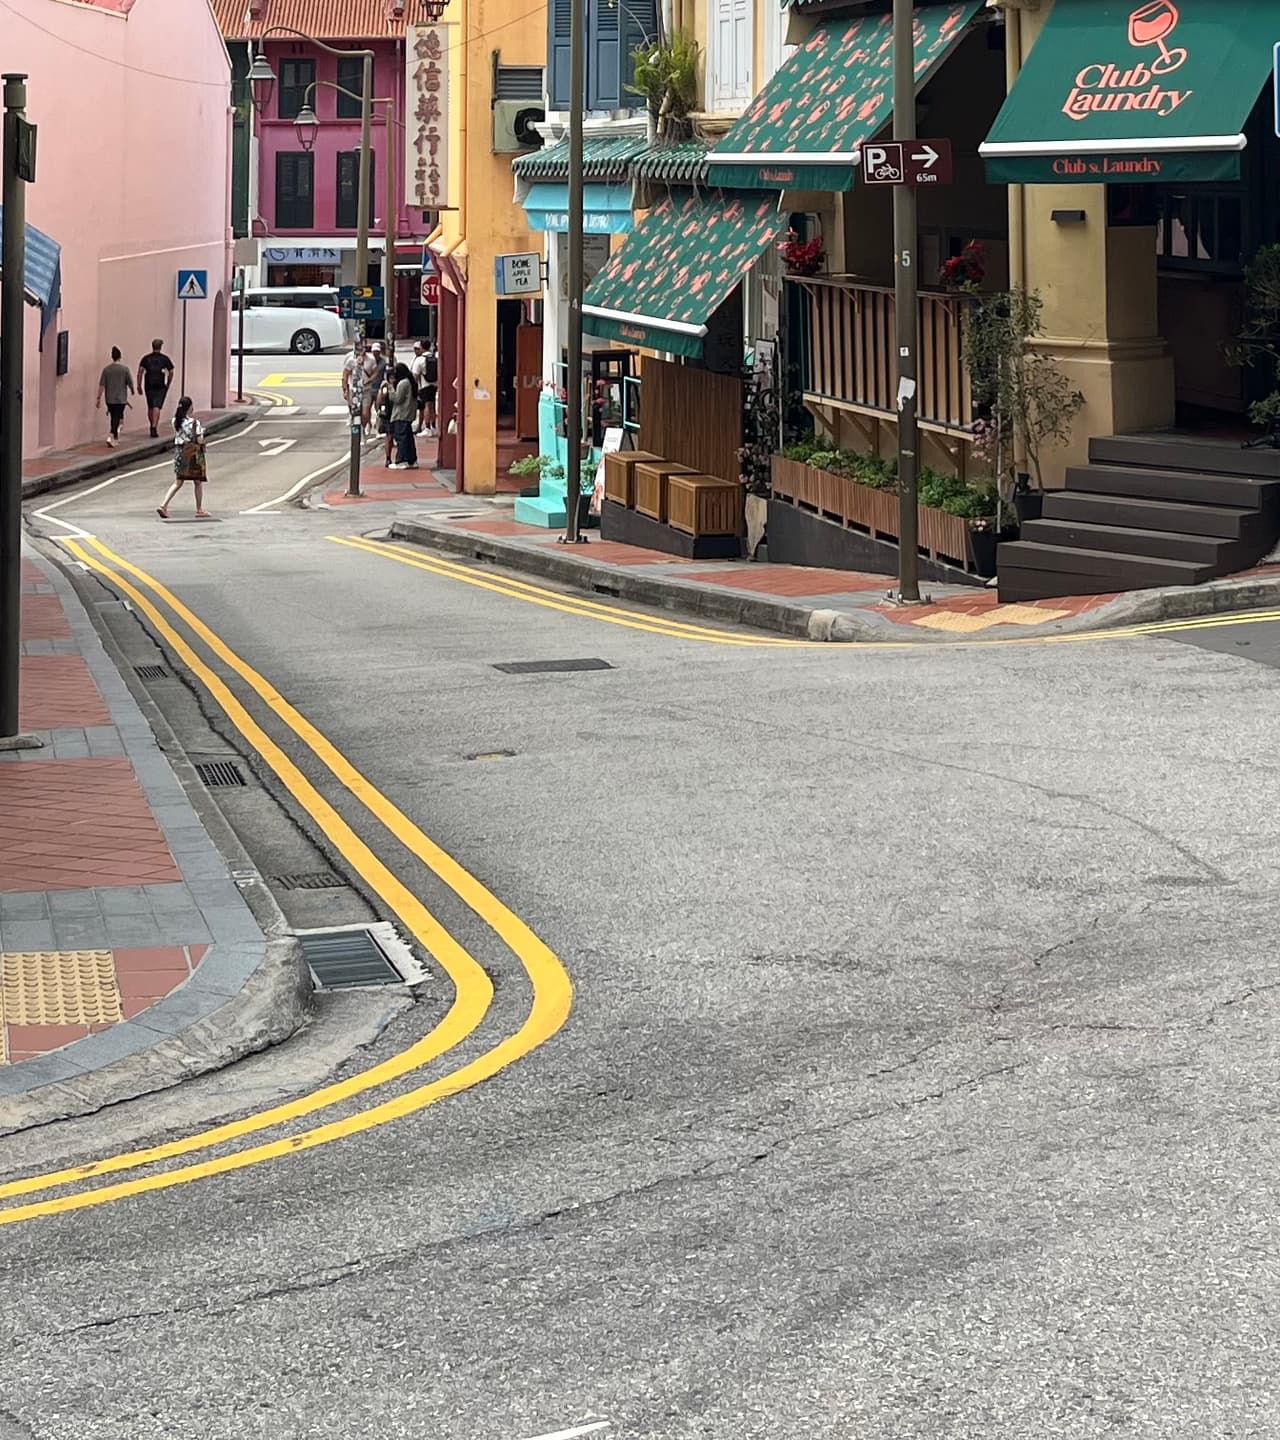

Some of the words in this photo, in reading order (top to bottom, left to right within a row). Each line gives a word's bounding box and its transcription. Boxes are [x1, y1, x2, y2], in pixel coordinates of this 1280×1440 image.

[1074, 62, 1153, 90] Club
[1060, 83, 1194, 122] Laundry
[866, 148, 887, 174] P
[1052, 157, 1086, 174] Club
[1103, 157, 1162, 176] Laundry
[916, 172, 937, 183] 65m
[901, 250, 911, 267] 5
